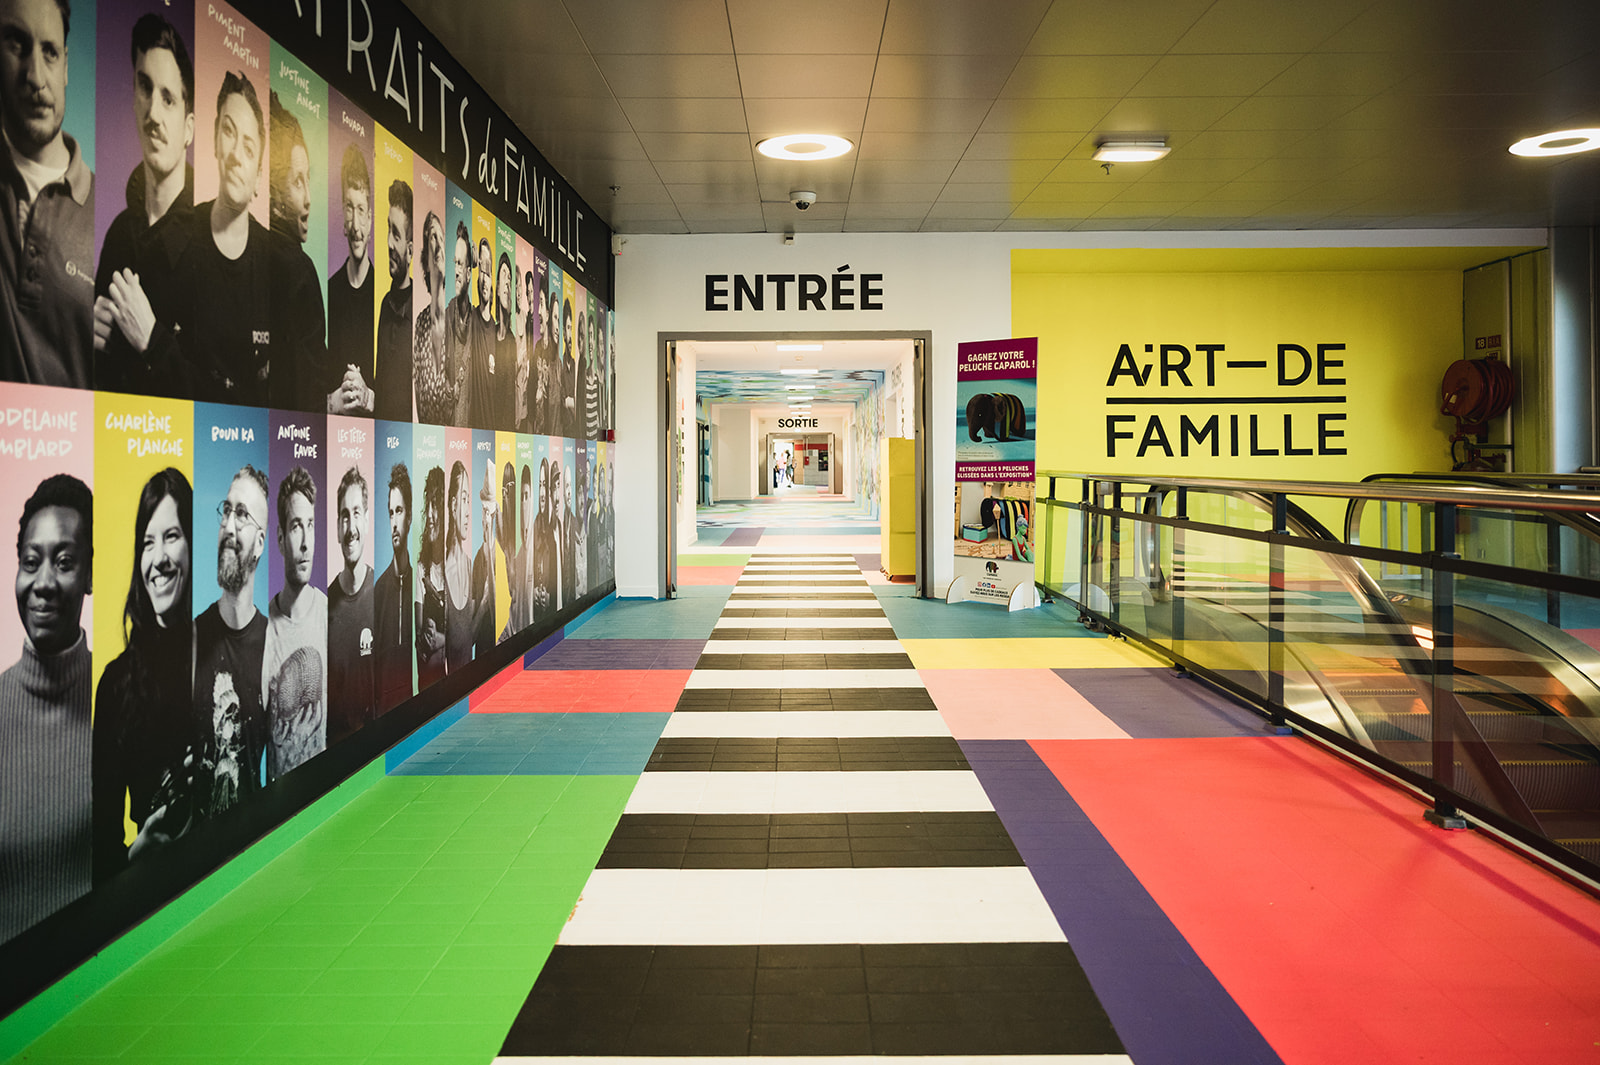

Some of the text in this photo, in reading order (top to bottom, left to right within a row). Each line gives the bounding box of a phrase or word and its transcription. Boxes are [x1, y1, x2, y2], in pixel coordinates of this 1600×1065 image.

[208, 4, 246, 44] PIMENT
[223, 36, 260, 70] MARTIN
[279, 61, 310, 95] JUSTINE
[478, 117, 499, 195] de
[705, 264, 883, 312] ENTRÉE
[959, 362, 993, 372] PELUCHE
[993, 360, 1031, 370] CAPAROL
[967, 350, 1024, 362] GAGNEZ VOTRE
[105, 410, 172, 434] CHARLÈNE
[778, 418, 819, 428] SORTIE
[211, 426, 255, 444] BOUN KA
[277, 424, 311, 442] ANTOINE
[337, 427, 349, 444] LES
[1106, 413, 1347, 458] FAMILLE
[127, 437, 184, 457] PLANCHE
[294, 443, 318, 459] FAVRE
